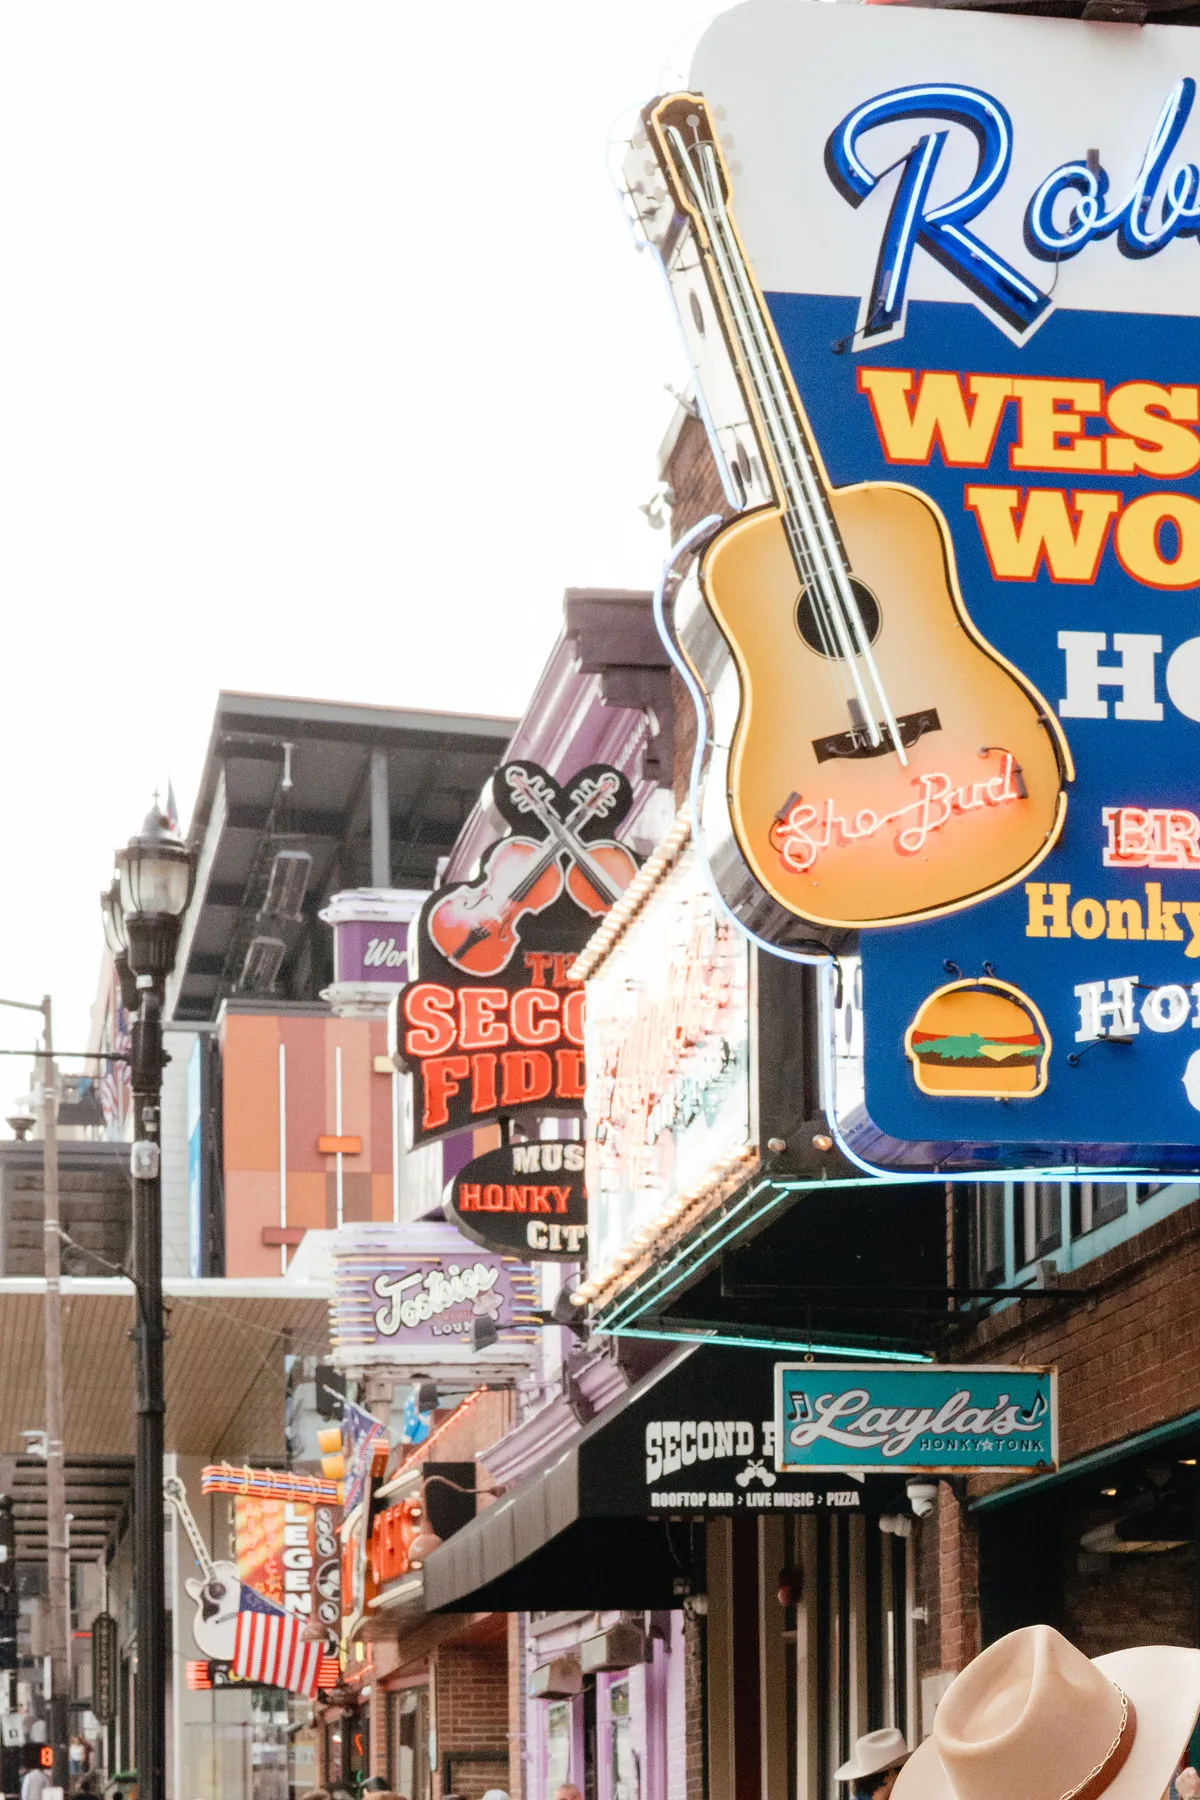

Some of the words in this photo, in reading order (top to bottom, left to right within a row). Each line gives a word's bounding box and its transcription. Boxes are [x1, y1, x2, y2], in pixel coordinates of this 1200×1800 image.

[459, 1183, 572, 1213] HONKY
[526, 1220, 588, 1252] CIT
[789, 1387, 1043, 1458] Layla's
[645, 1421, 754, 1485] SECOND
[919, 1437, 980, 1453] HONKY
[995, 1437, 1045, 1453] TONK
[651, 1491, 708, 1508] ROOFTOP
[708, 1491, 734, 1508] BAR
[746, 1491, 772, 1508] LIVE
[773, 1491, 815, 1508] MUSIC
[826, 1490, 860, 1507] PIZZA
